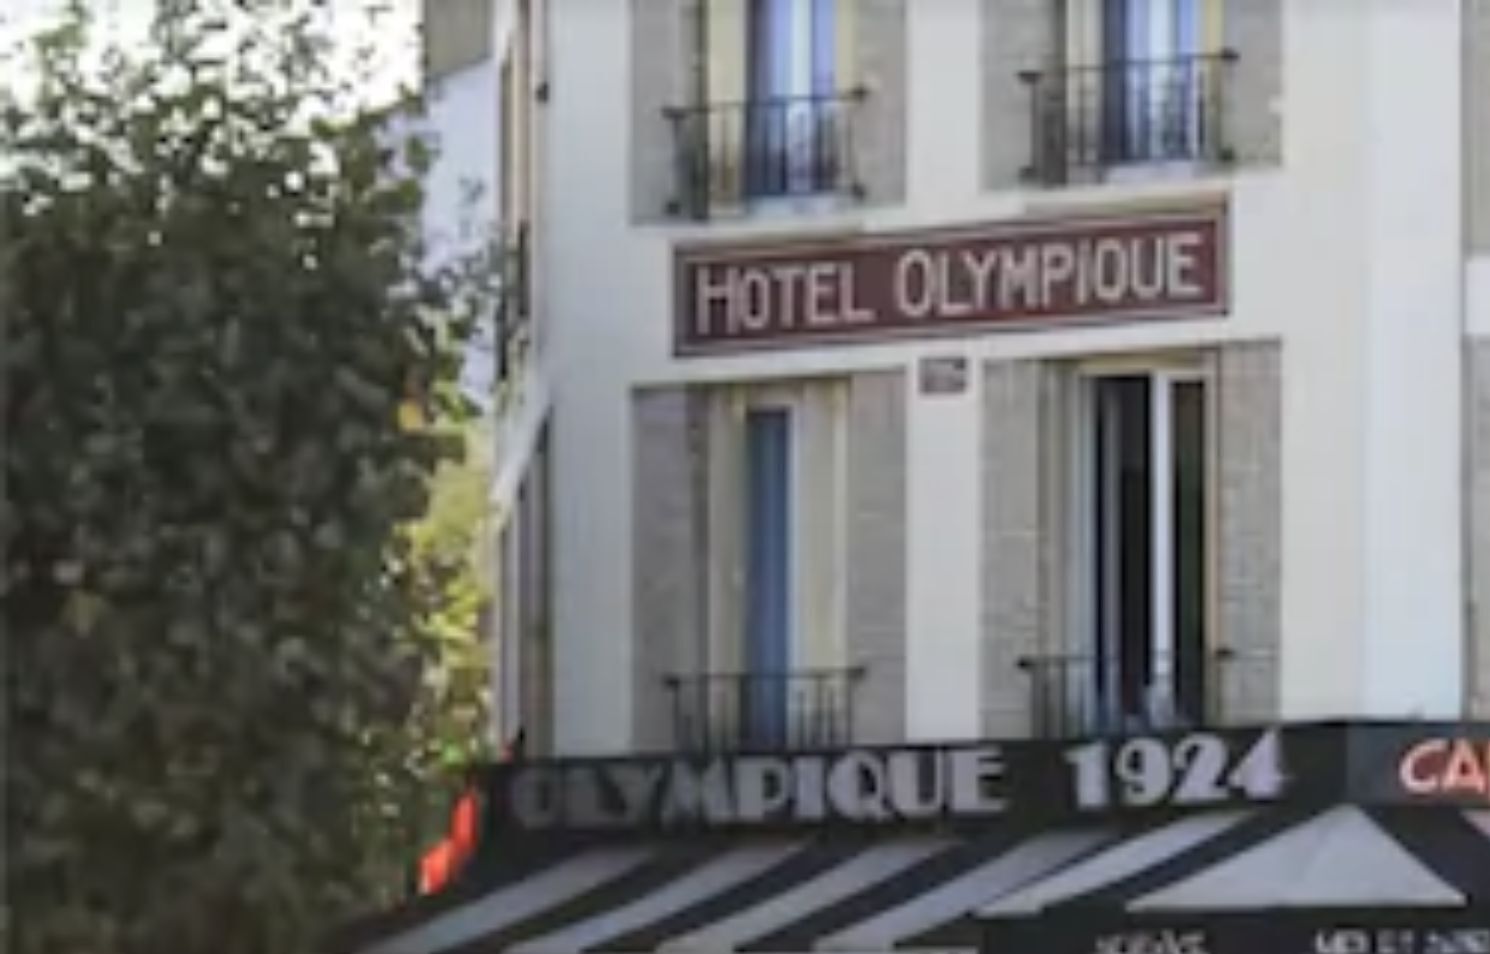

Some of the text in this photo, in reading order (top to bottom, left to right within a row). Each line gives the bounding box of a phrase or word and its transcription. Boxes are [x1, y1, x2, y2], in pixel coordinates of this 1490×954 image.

[694, 231, 1206, 338] HOTEL OLYMPIQUE
[510, 727, 1288, 829] OLYMPIQUE 1924
